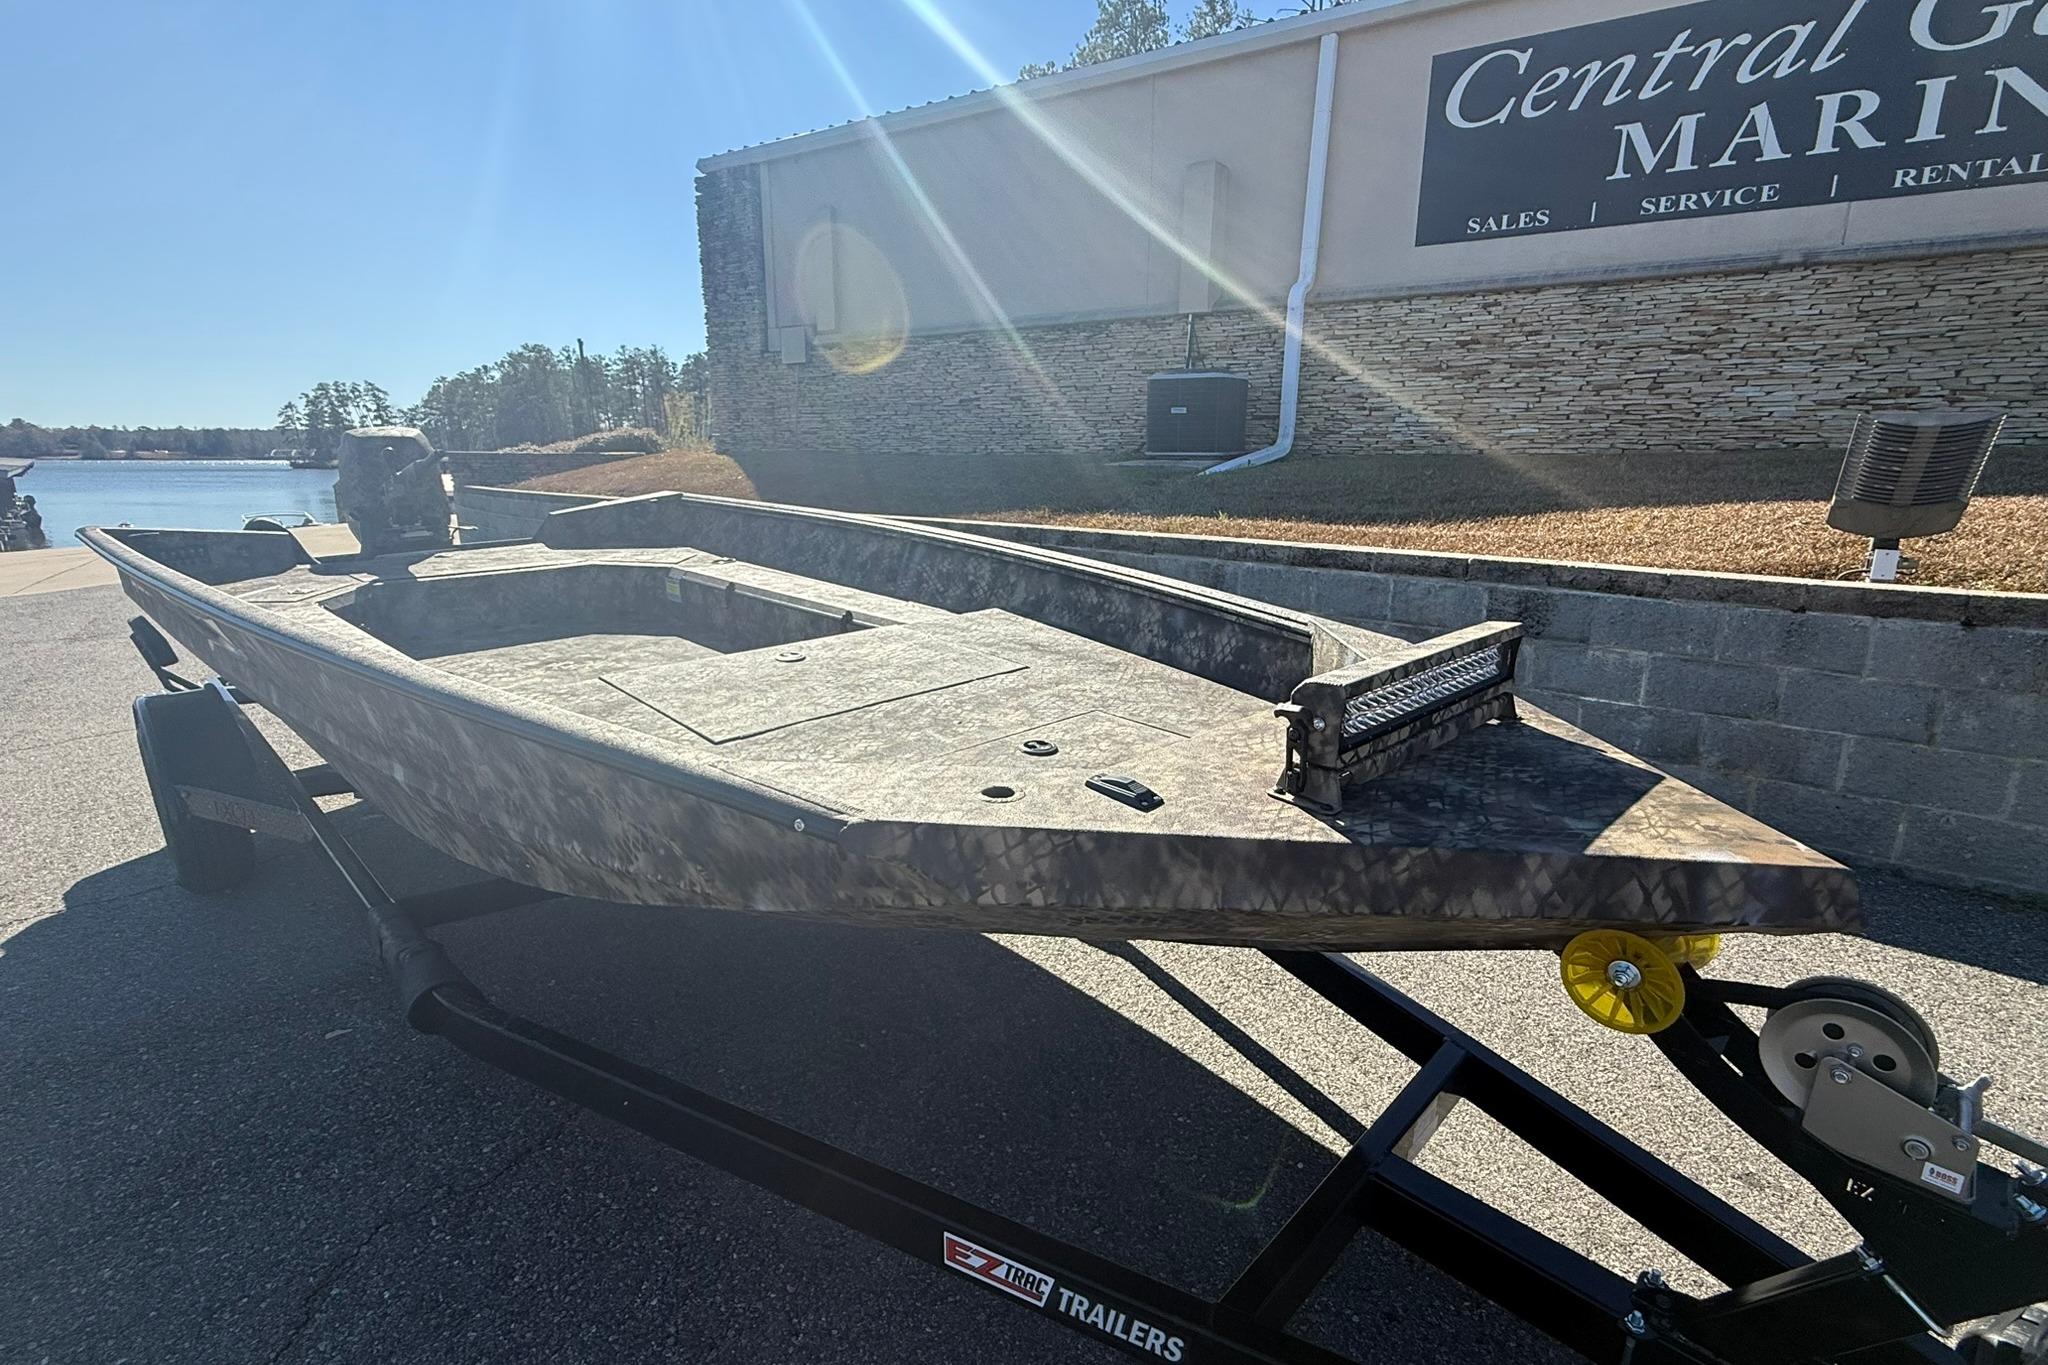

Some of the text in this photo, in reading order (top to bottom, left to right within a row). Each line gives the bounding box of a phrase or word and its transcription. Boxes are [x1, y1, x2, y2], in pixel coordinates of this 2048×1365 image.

[1445, 0, 1869, 129] Central
[1467, 209, 1550, 234] SALES
[1640, 183, 1780, 216] SERVICE
[1003, 1261, 1050, 1297] TRAC
[1058, 1286, 1186, 1363] TRAILERS
